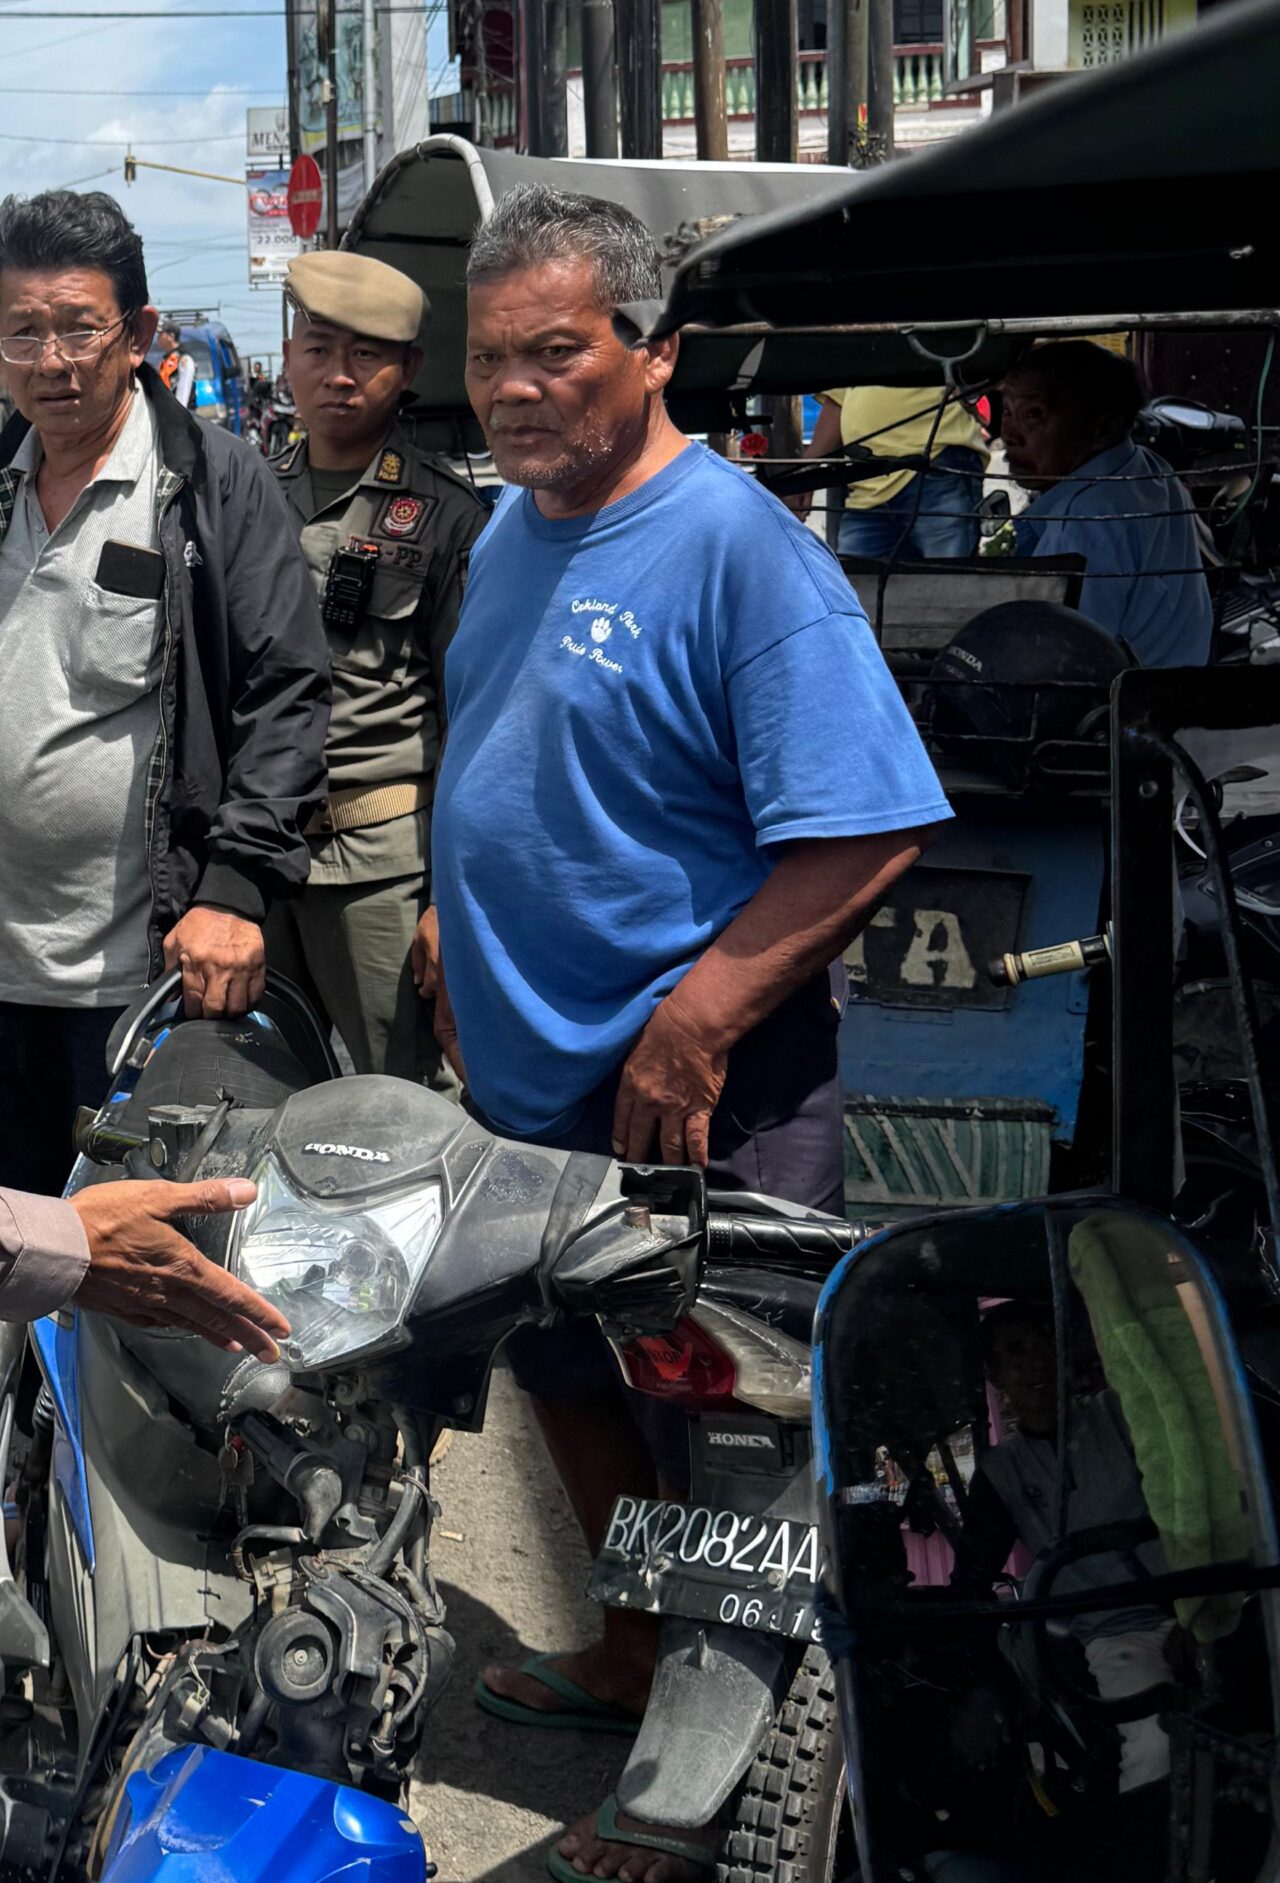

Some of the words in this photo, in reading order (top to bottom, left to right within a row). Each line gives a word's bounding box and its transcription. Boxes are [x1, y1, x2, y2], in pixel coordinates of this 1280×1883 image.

[571, 598, 619, 615] Oakland
[619, 610, 643, 640] Park
[559, 635, 587, 656] Pride
[588, 647, 624, 674] Power
[303, 1142, 391, 1163] HONDA
[706, 1431, 776, 1449] HONDA
